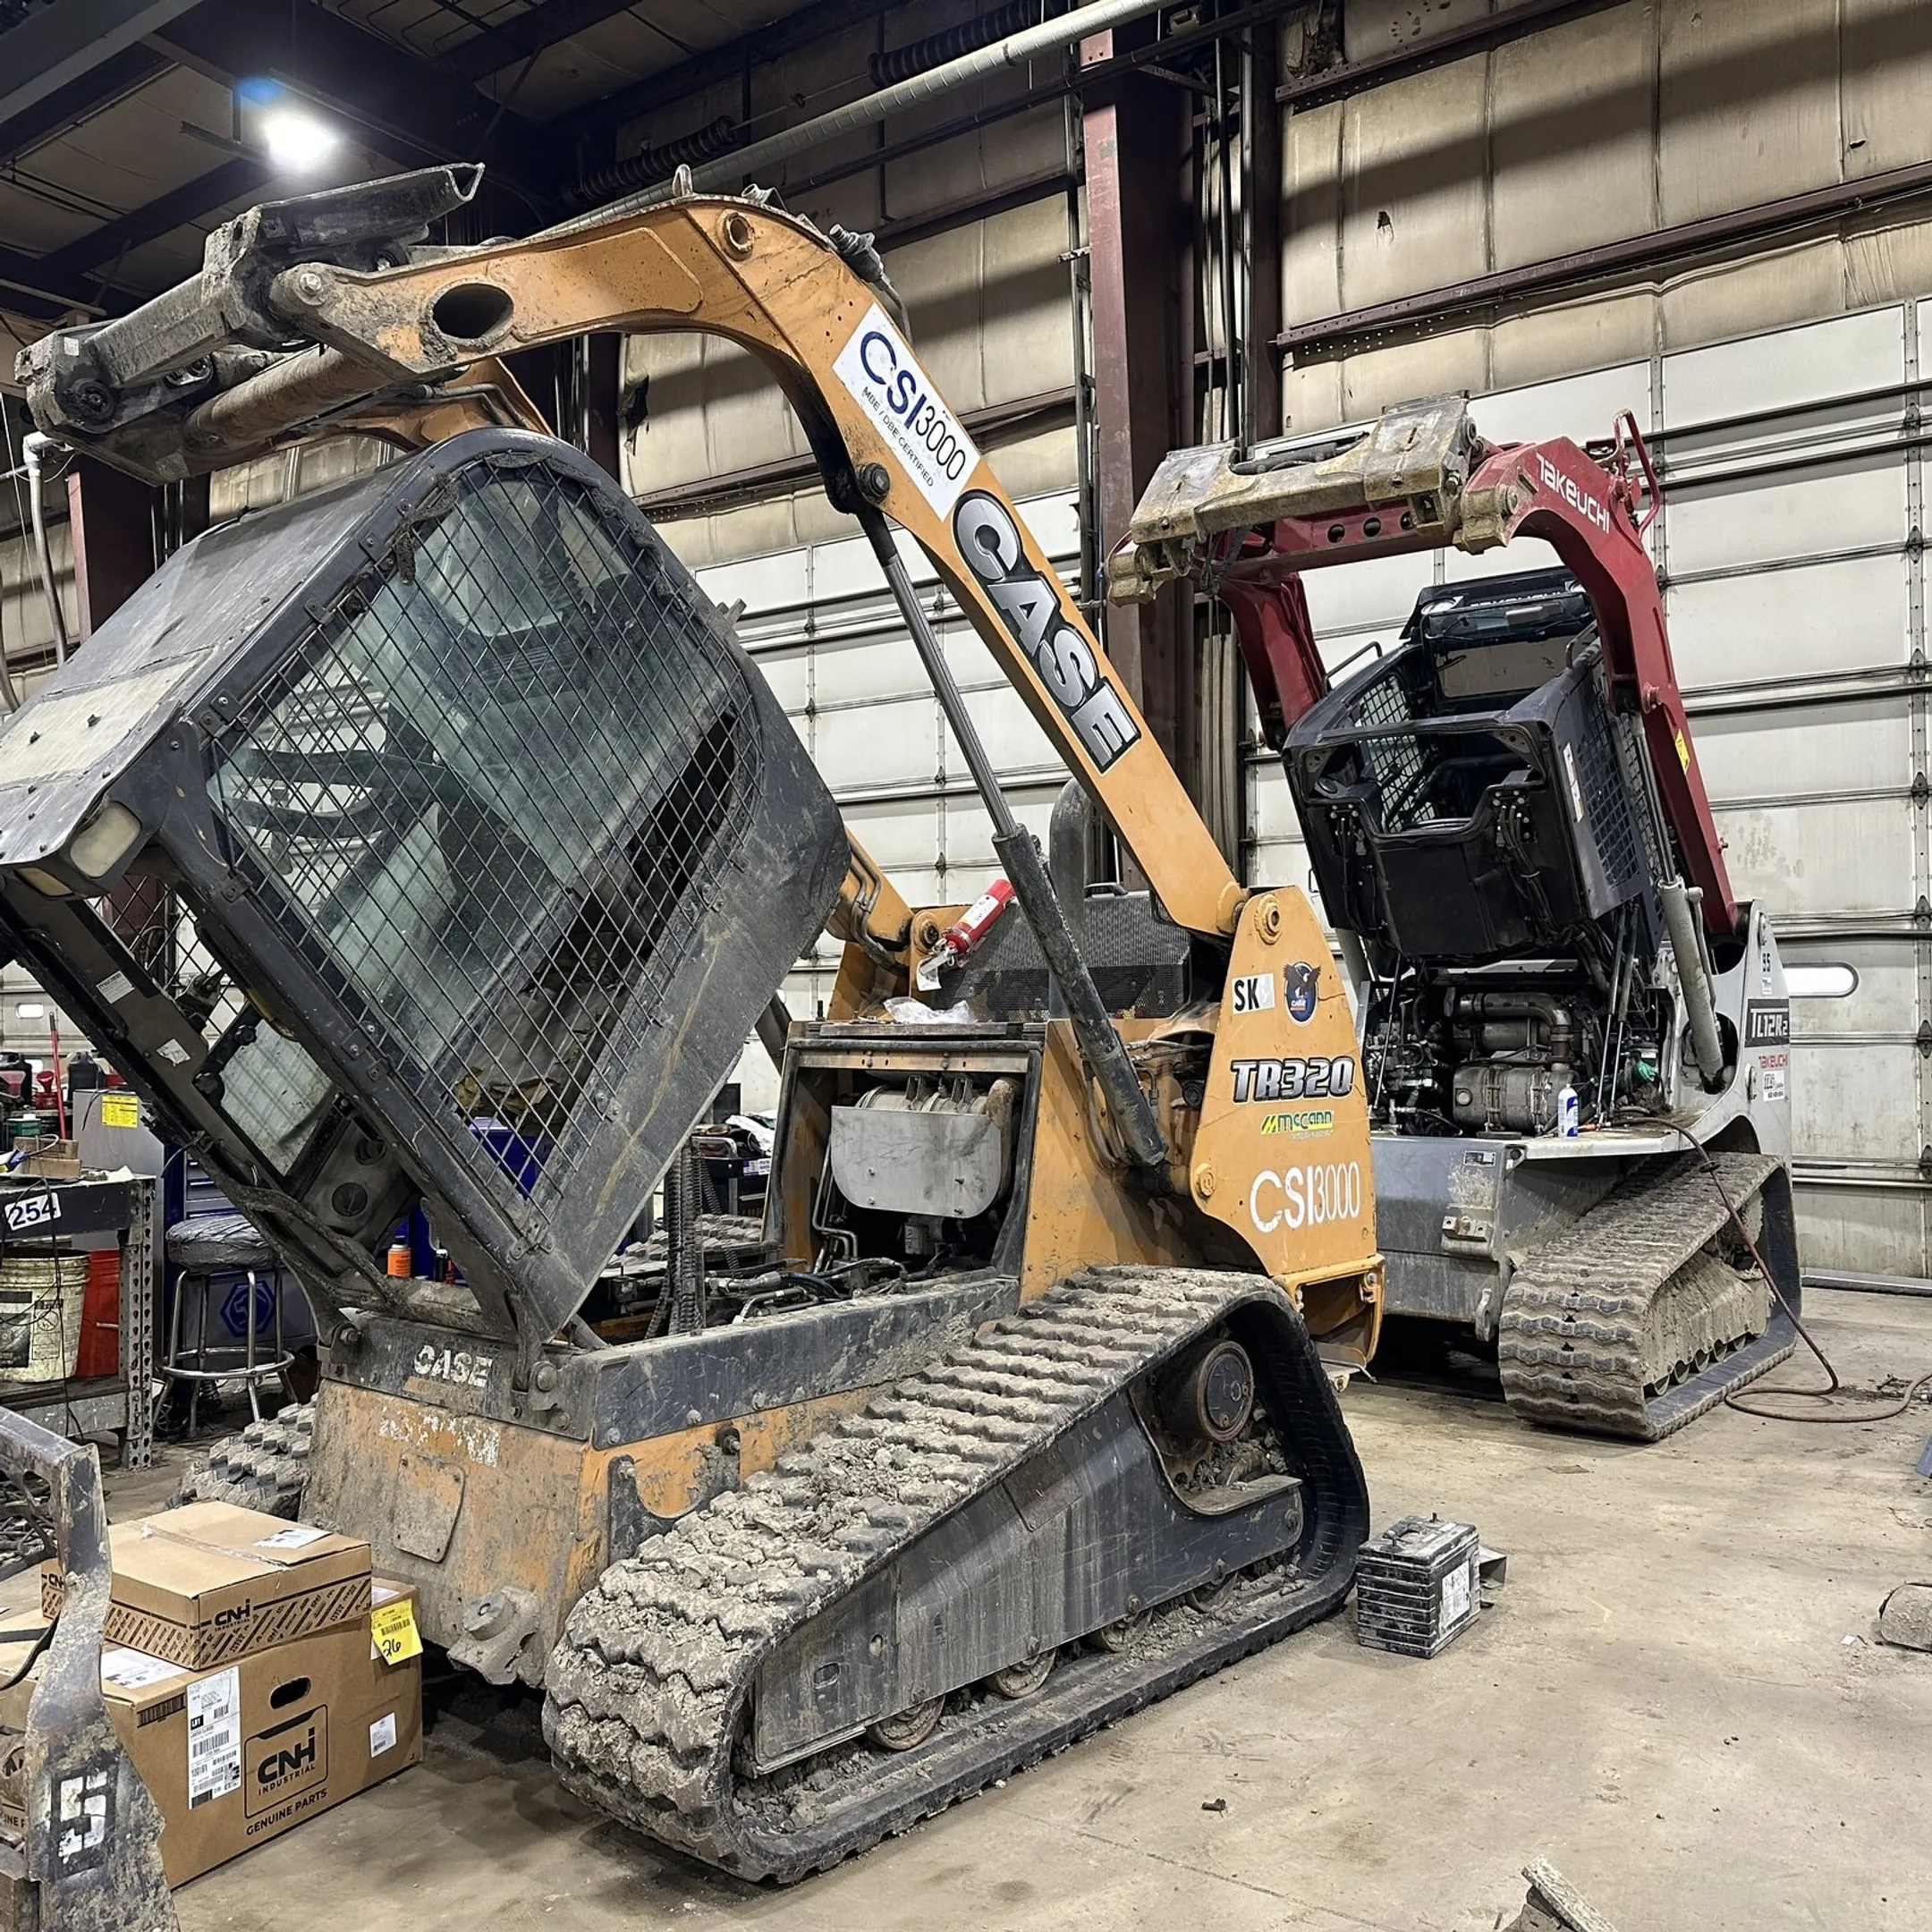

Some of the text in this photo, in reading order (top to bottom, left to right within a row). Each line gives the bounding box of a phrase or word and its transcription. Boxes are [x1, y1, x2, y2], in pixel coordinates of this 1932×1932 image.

[863, 386, 878, 411] MBE
[883, 414, 901, 437] DBE
[899, 436, 934, 487] CERTIFIED
[955, 492, 1140, 770] CASE
[1231, 1056, 1354, 1102] TR320
[12, 1198, 57, 1227] 254
[1250, 1161, 1360, 1233] CSI3000
[414, 1344, 493, 1387] CASE
[258, 1764, 316, 1796] INDUSTRIAL
[246, 1788, 327, 1835] GENUINE PARTS
